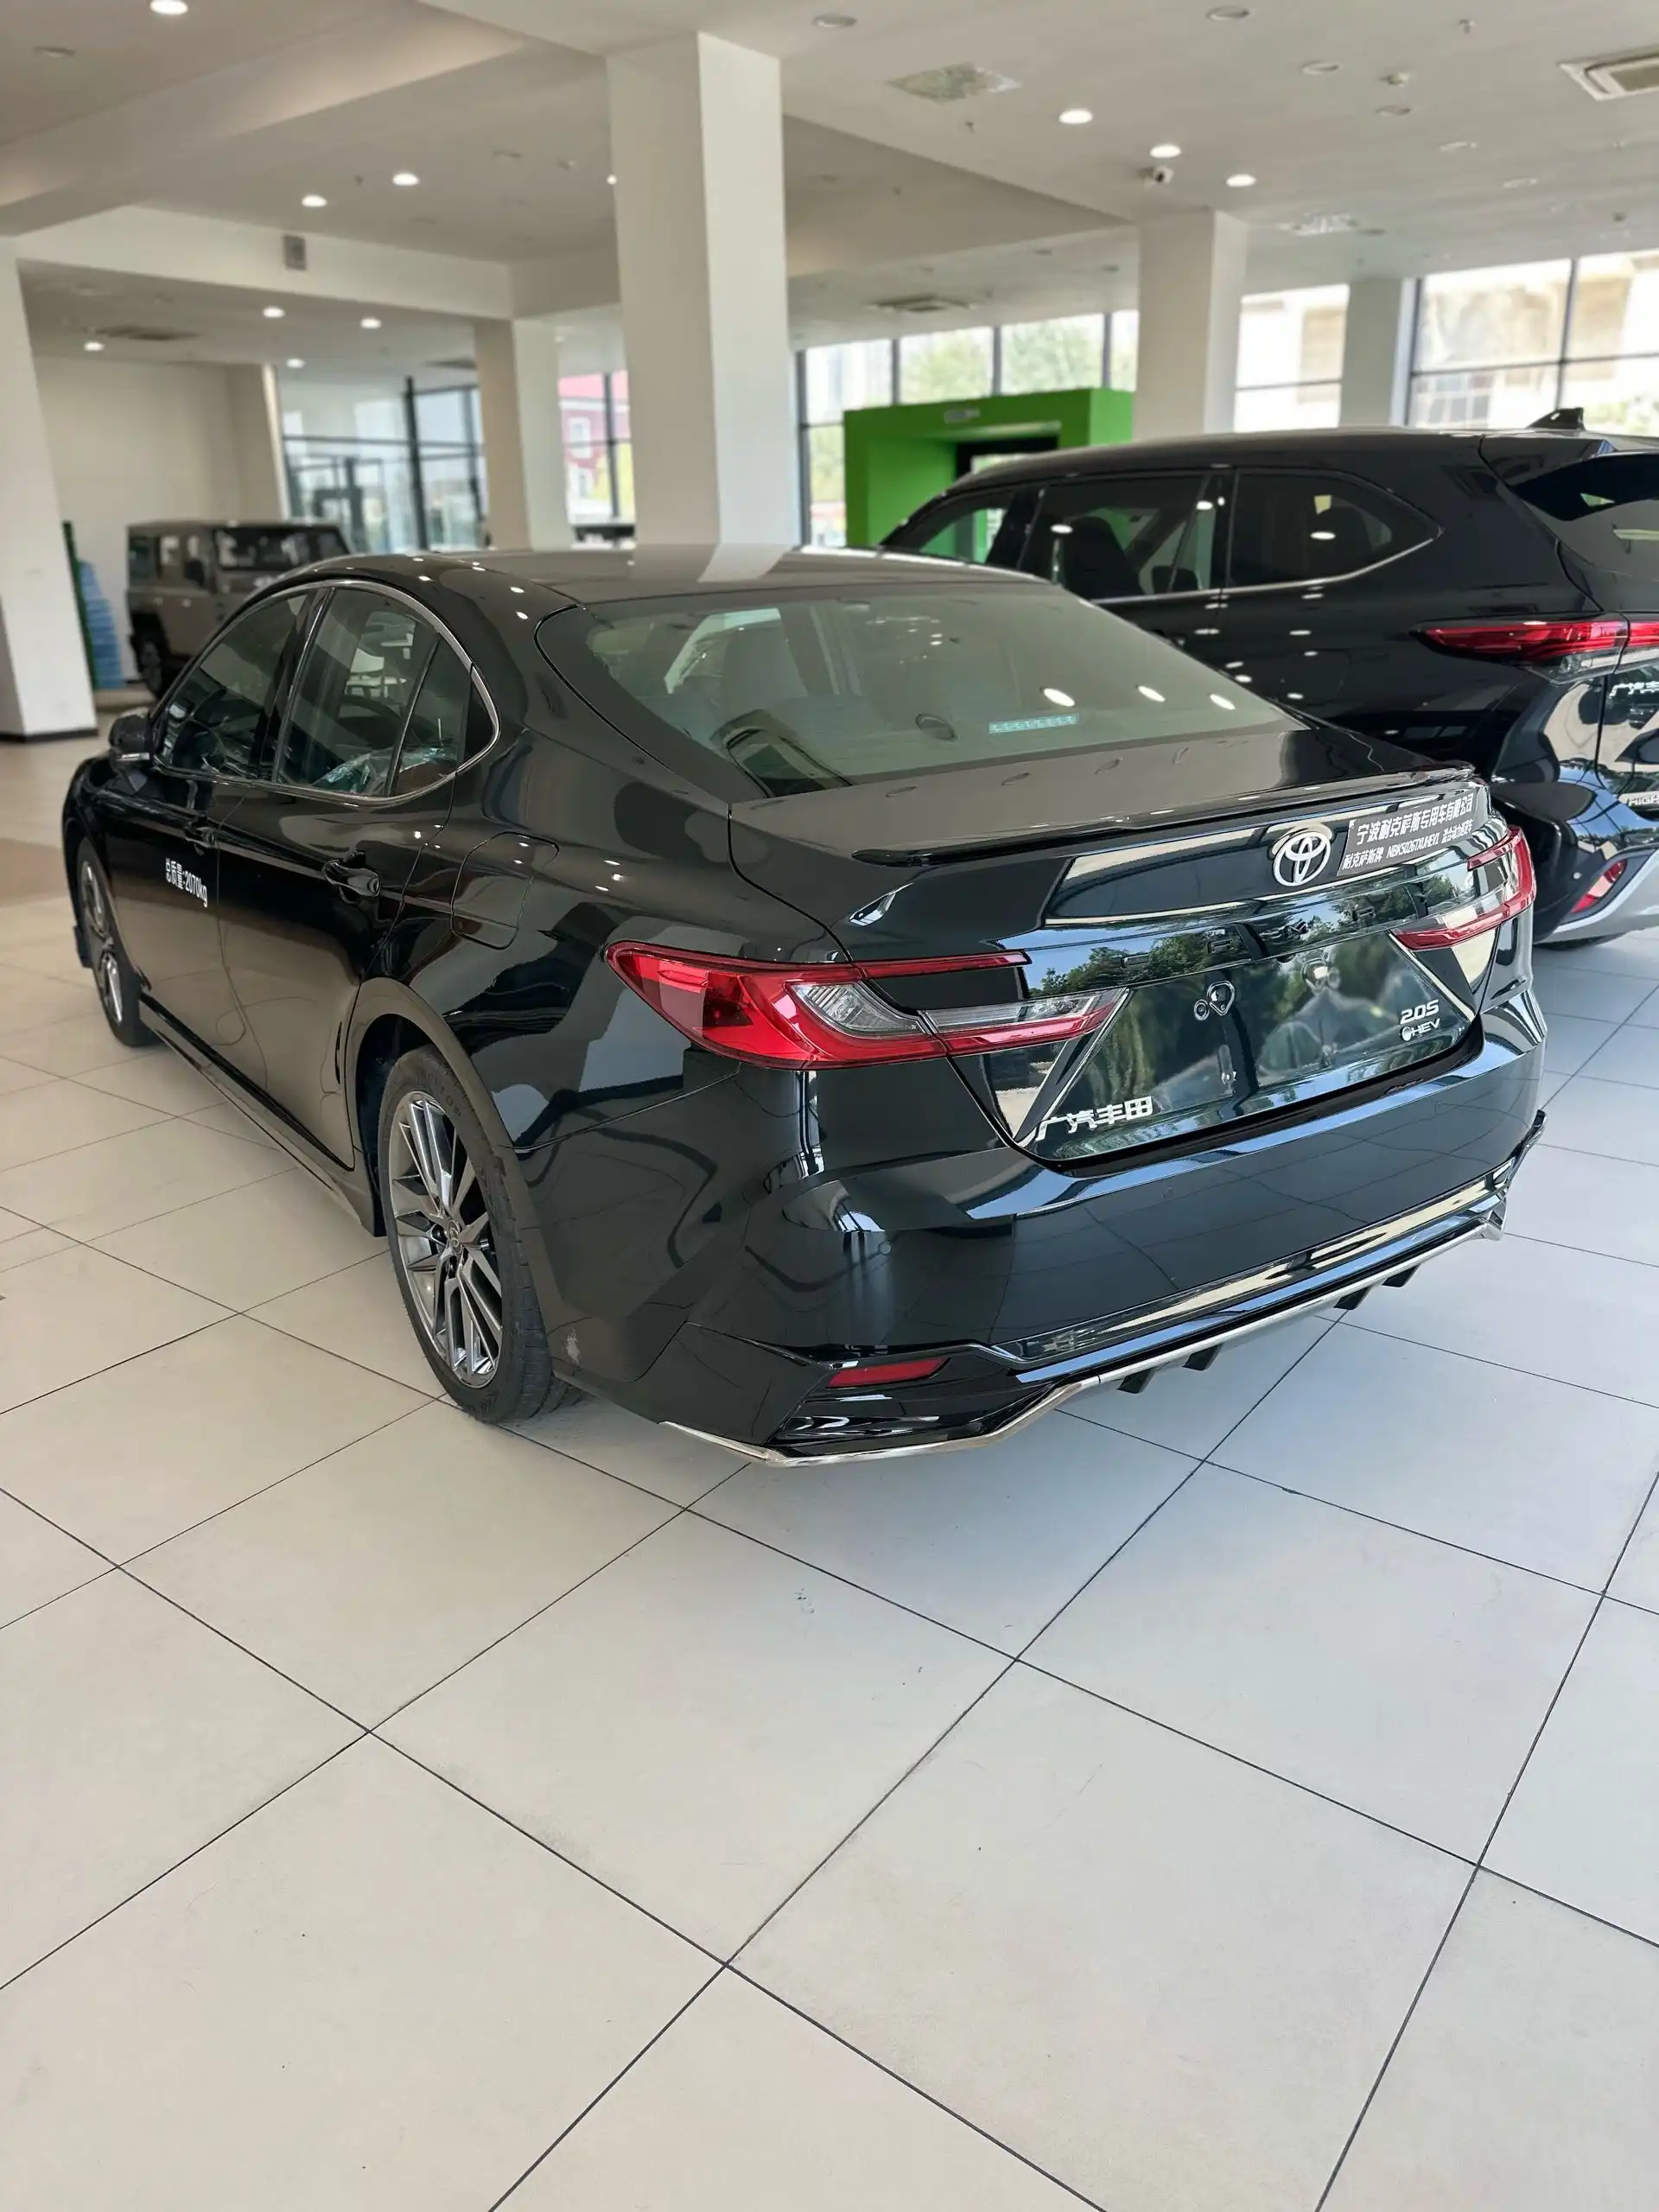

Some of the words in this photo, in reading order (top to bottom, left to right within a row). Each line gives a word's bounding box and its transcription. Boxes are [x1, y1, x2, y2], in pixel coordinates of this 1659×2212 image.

[1357, 793, 1474, 845] 宁波耐克萨斯专用车有限公司
[1035, 1096, 1154, 1141] 广汽丰田
